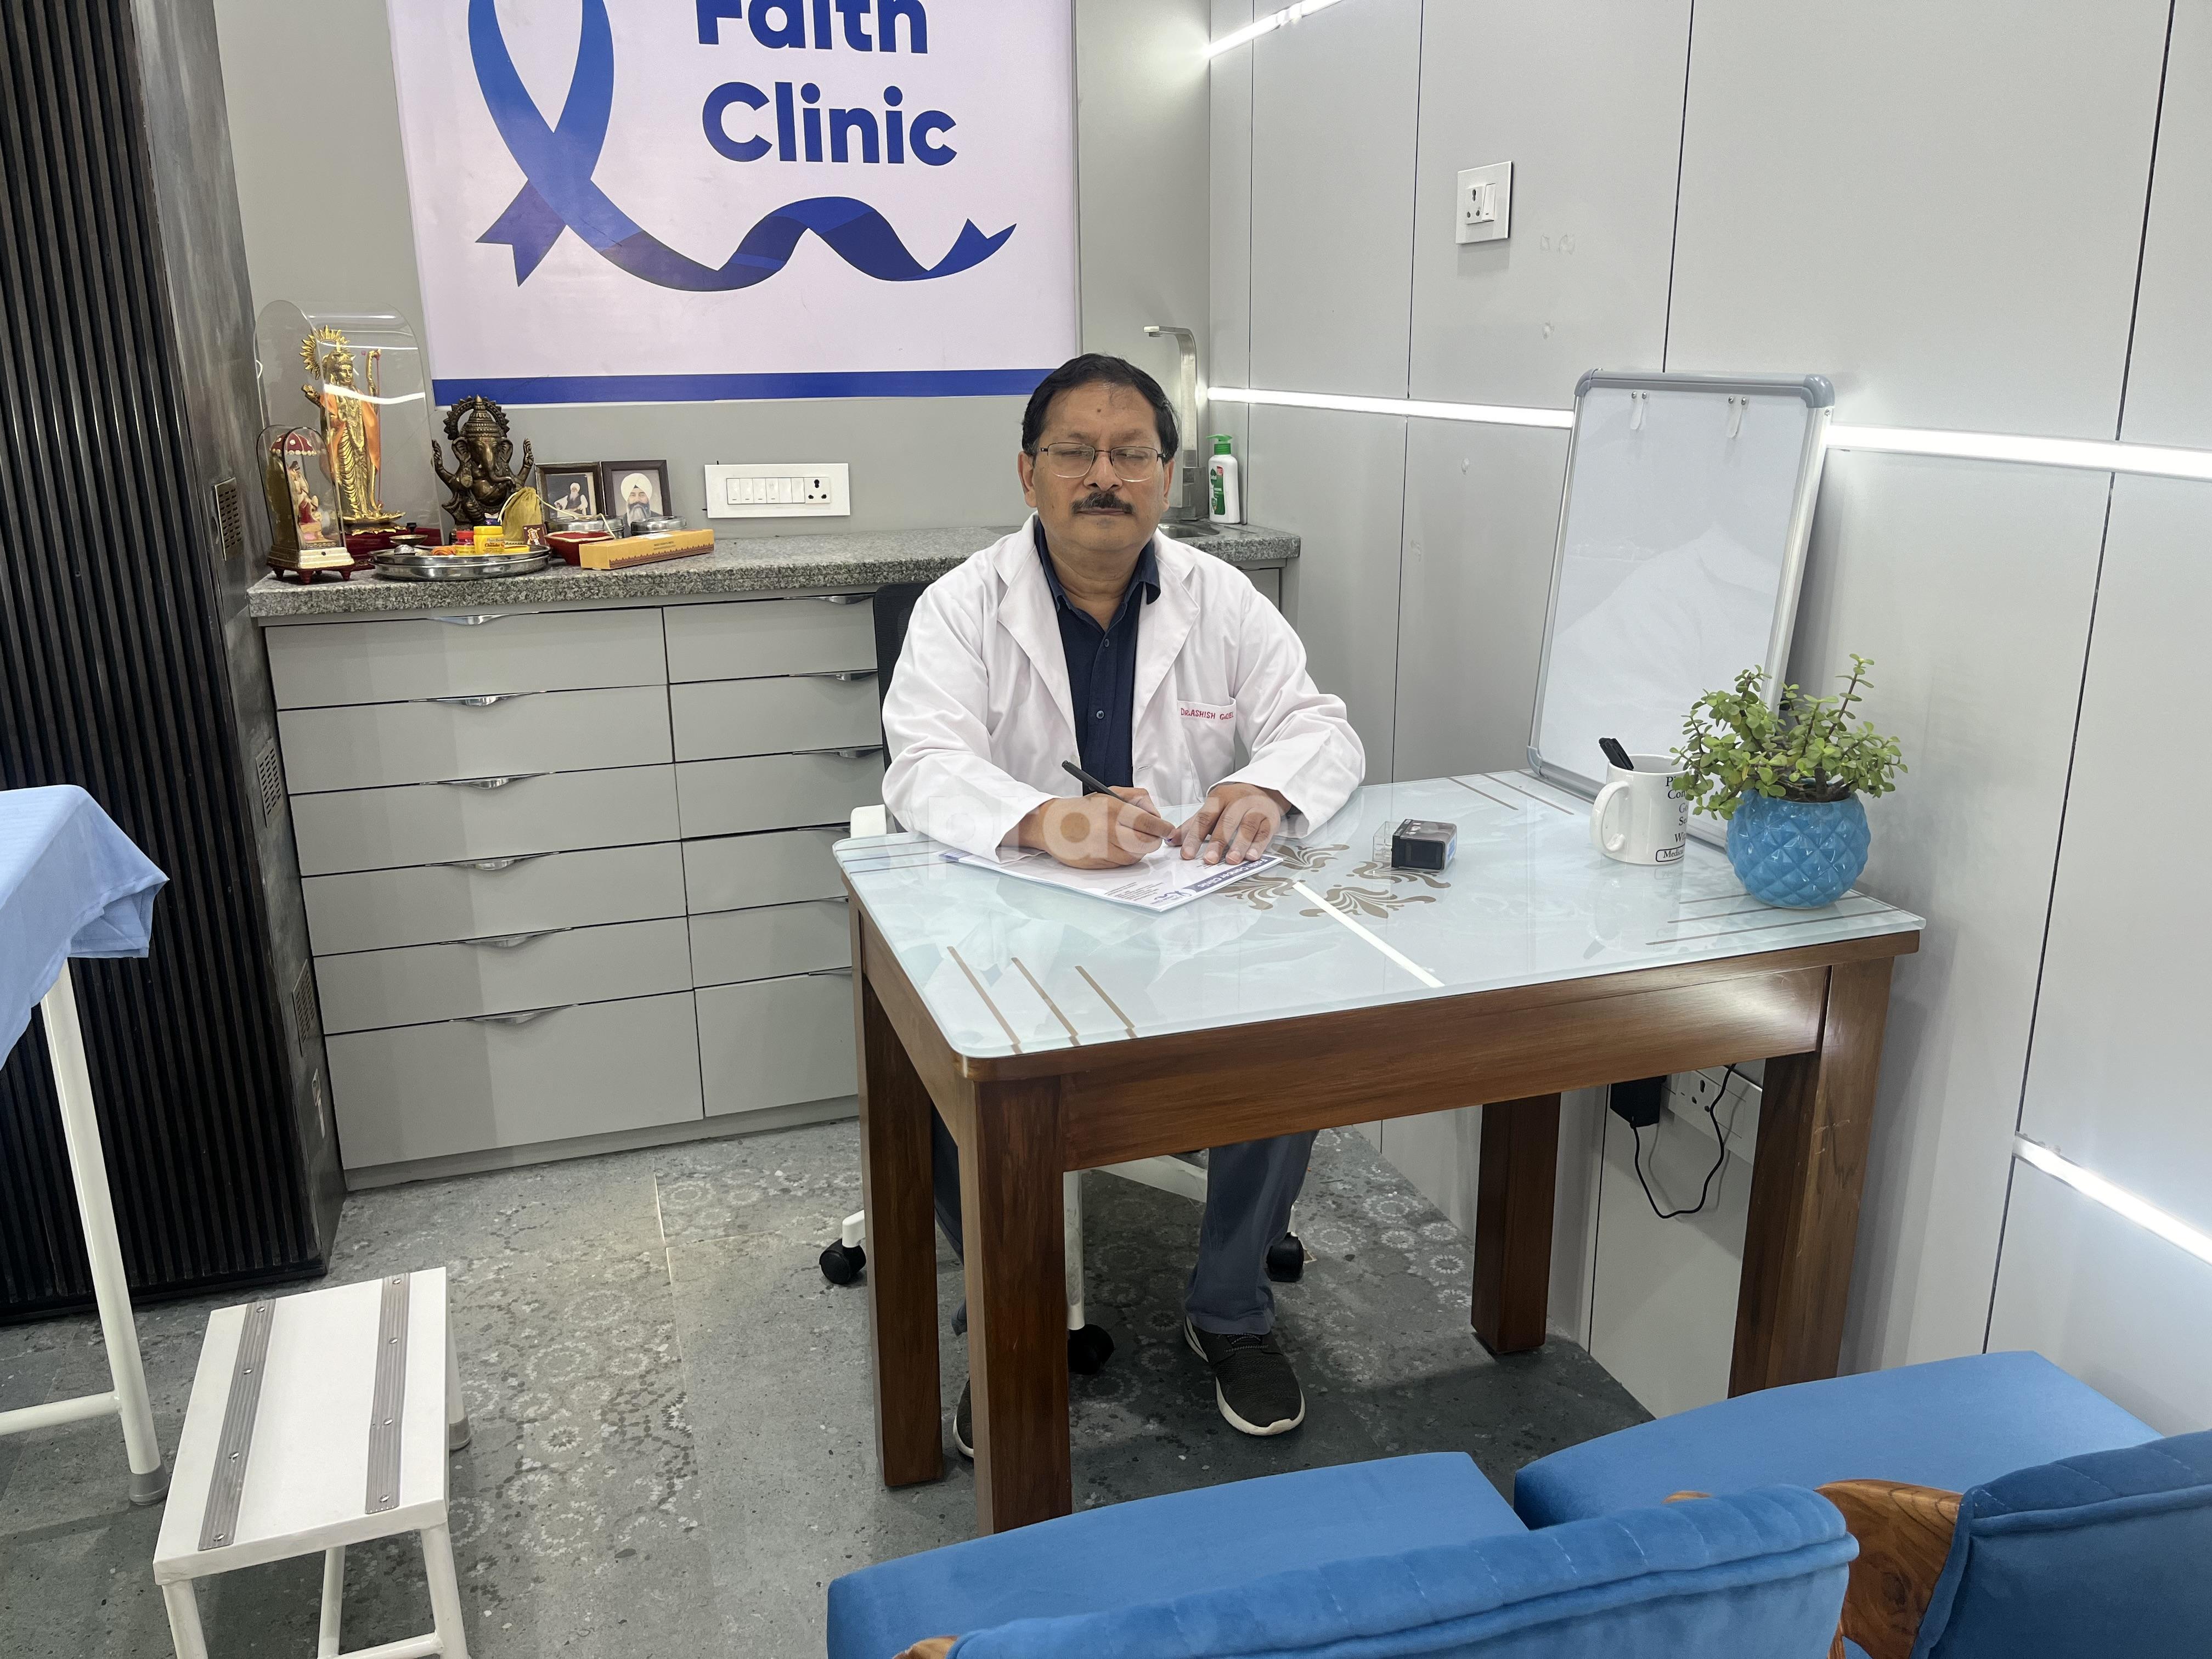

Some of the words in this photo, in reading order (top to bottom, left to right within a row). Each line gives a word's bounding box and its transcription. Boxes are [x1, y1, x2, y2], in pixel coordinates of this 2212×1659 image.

[702, 81, 958, 166] Clinic
[1220, 866, 1249, 878] Cancer
[1197, 877, 1222, 888] Clinic
